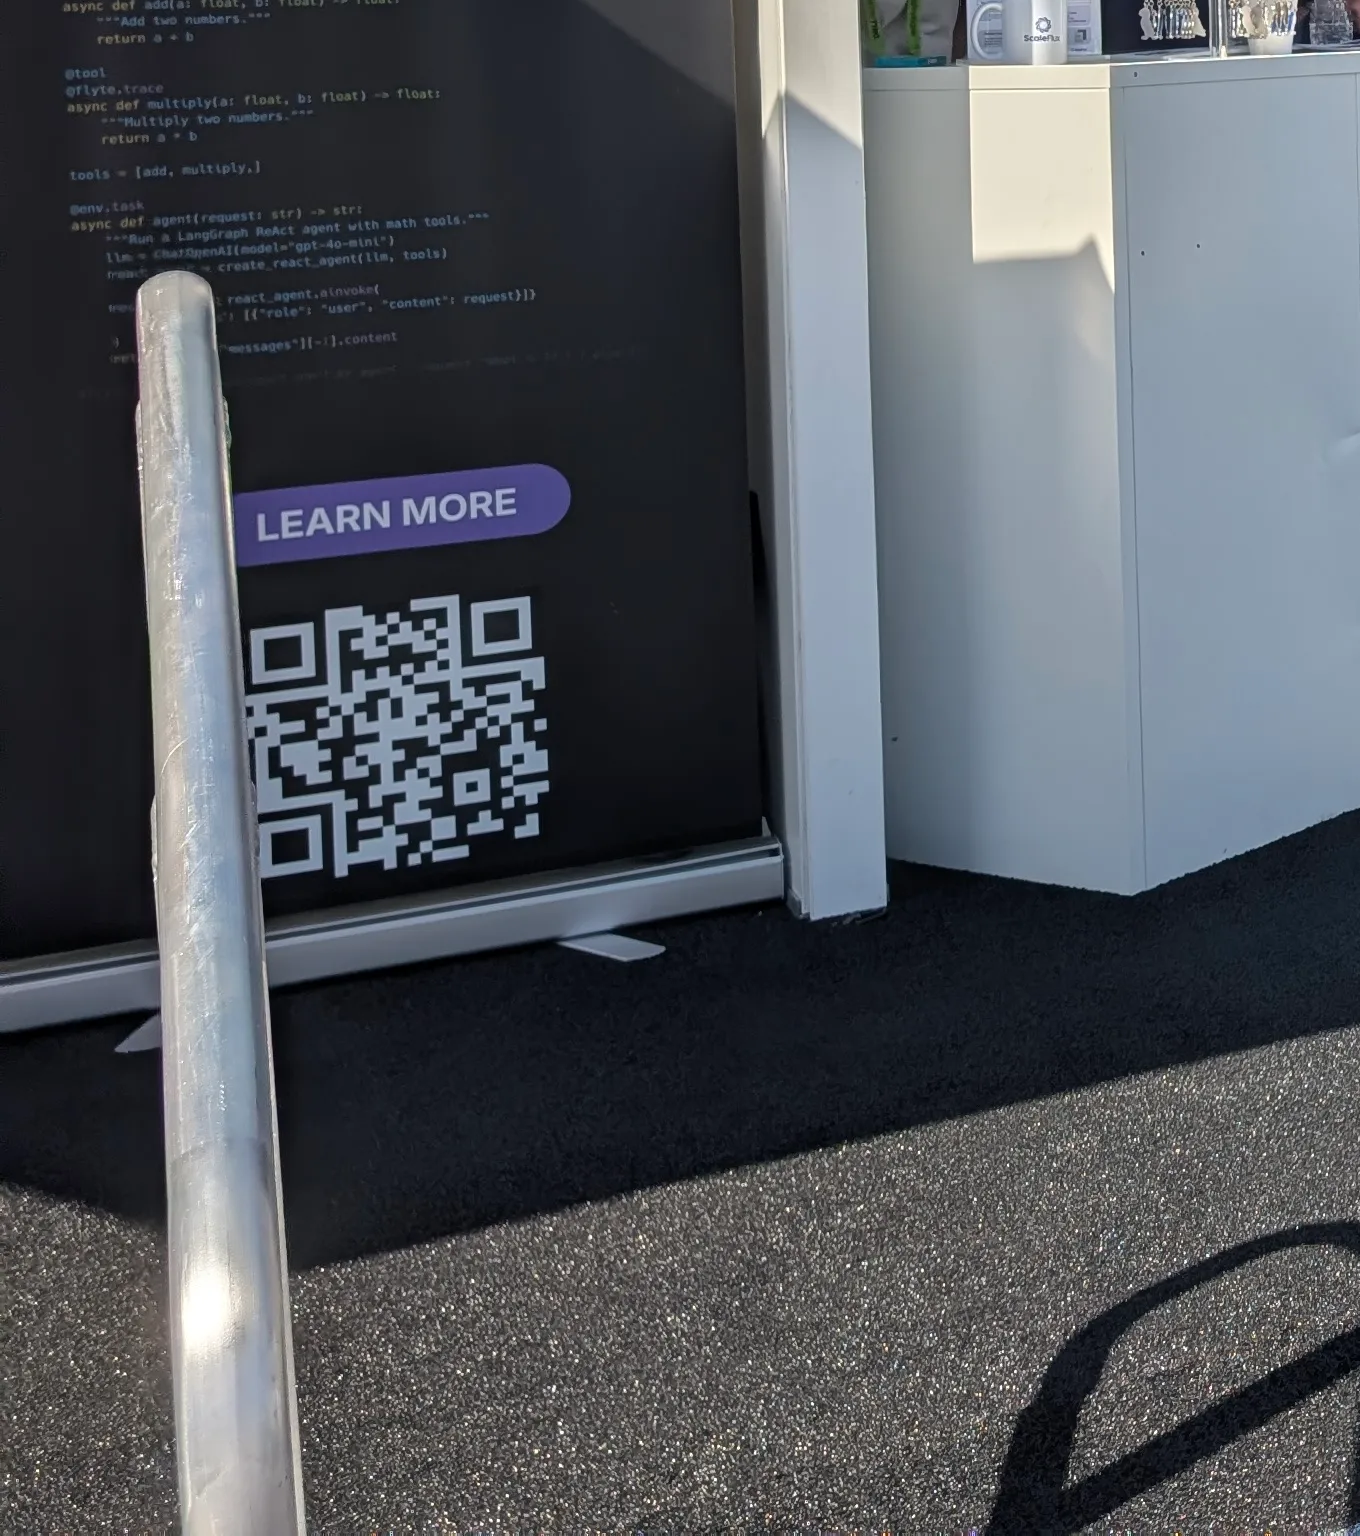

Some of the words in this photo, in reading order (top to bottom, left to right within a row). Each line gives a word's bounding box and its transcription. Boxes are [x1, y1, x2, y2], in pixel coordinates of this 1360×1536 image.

[63, 2, 104, 14] async
[111, 0, 136, 12] def
[152, 15, 178, 26] two
[97, 33, 146, 45] return
[67, 102, 108, 115] async
[115, 98, 140, 111] def
[196, 114, 222, 125] two
[101, 134, 150, 145] return
[69, 168, 111, 181] tools
[71, 219, 112, 233] async
[119, 215, 145, 229] def
[302, 222, 341, 237] agent
[347, 219, 380, 232] with
[385, 217, 417, 229] math
[256, 500, 390, 542] LEARN
[402, 488, 517, 526] MORE
